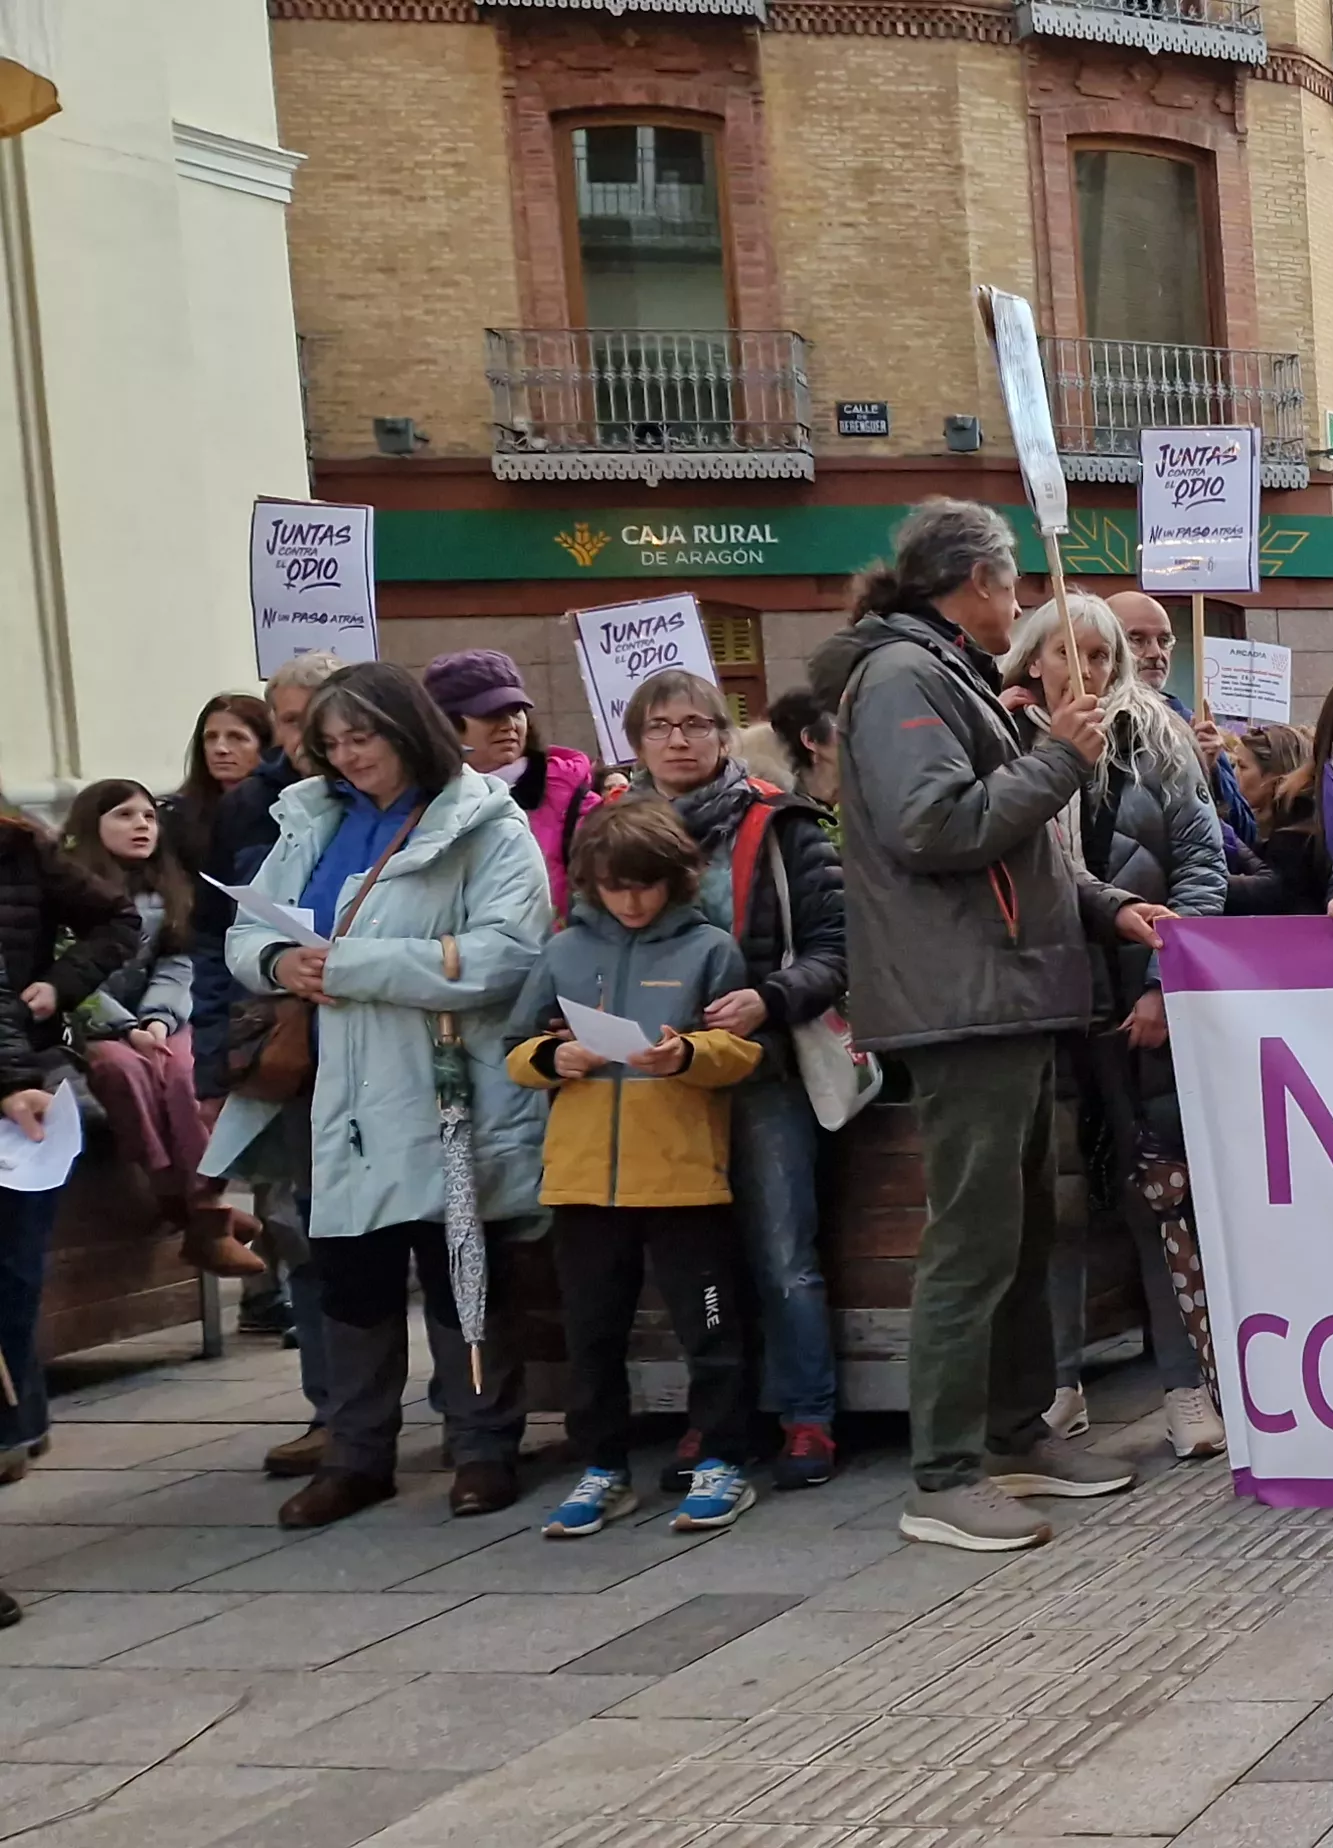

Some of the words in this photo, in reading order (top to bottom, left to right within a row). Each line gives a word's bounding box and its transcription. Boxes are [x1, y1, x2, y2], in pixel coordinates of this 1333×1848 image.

[844, 404, 878, 414] CALLE
[1155, 442, 1239, 478] JUNTAS
[1167, 468, 1206, 478] CONTRA
[1165, 480, 1176, 489] EL
[1174, 476, 1225, 502] ODIO
[266, 518, 352, 555] JUNTAS
[621, 524, 687, 546] CAJA
[693, 524, 779, 544] RURAL
[1149, 525, 1163, 544] NI
[1163, 530, 1175, 538] UN
[1176, 527, 1211, 538] PASO
[1211, 525, 1244, 537] ATRÁS
[277, 546, 319, 557] CONTRA
[641, 551, 669, 566] DE
[675, 547, 764, 565] ARAGÓN
[275, 559, 287, 569] EL
[286, 557, 339, 584] ODIO
[262, 608, 277, 629] NI
[278, 613, 290, 622] UN
[292, 612, 328, 624] PASO
[329, 612, 365, 625] ATRÁS
[599, 611, 685, 655] JUNTAS
[614, 638, 656, 653] CONTRA
[615, 655, 626, 665] EL
[627, 642, 679, 674] ODIO
[611, 698, 624, 718] NI
[704, 1285, 720, 1329] NIKE
